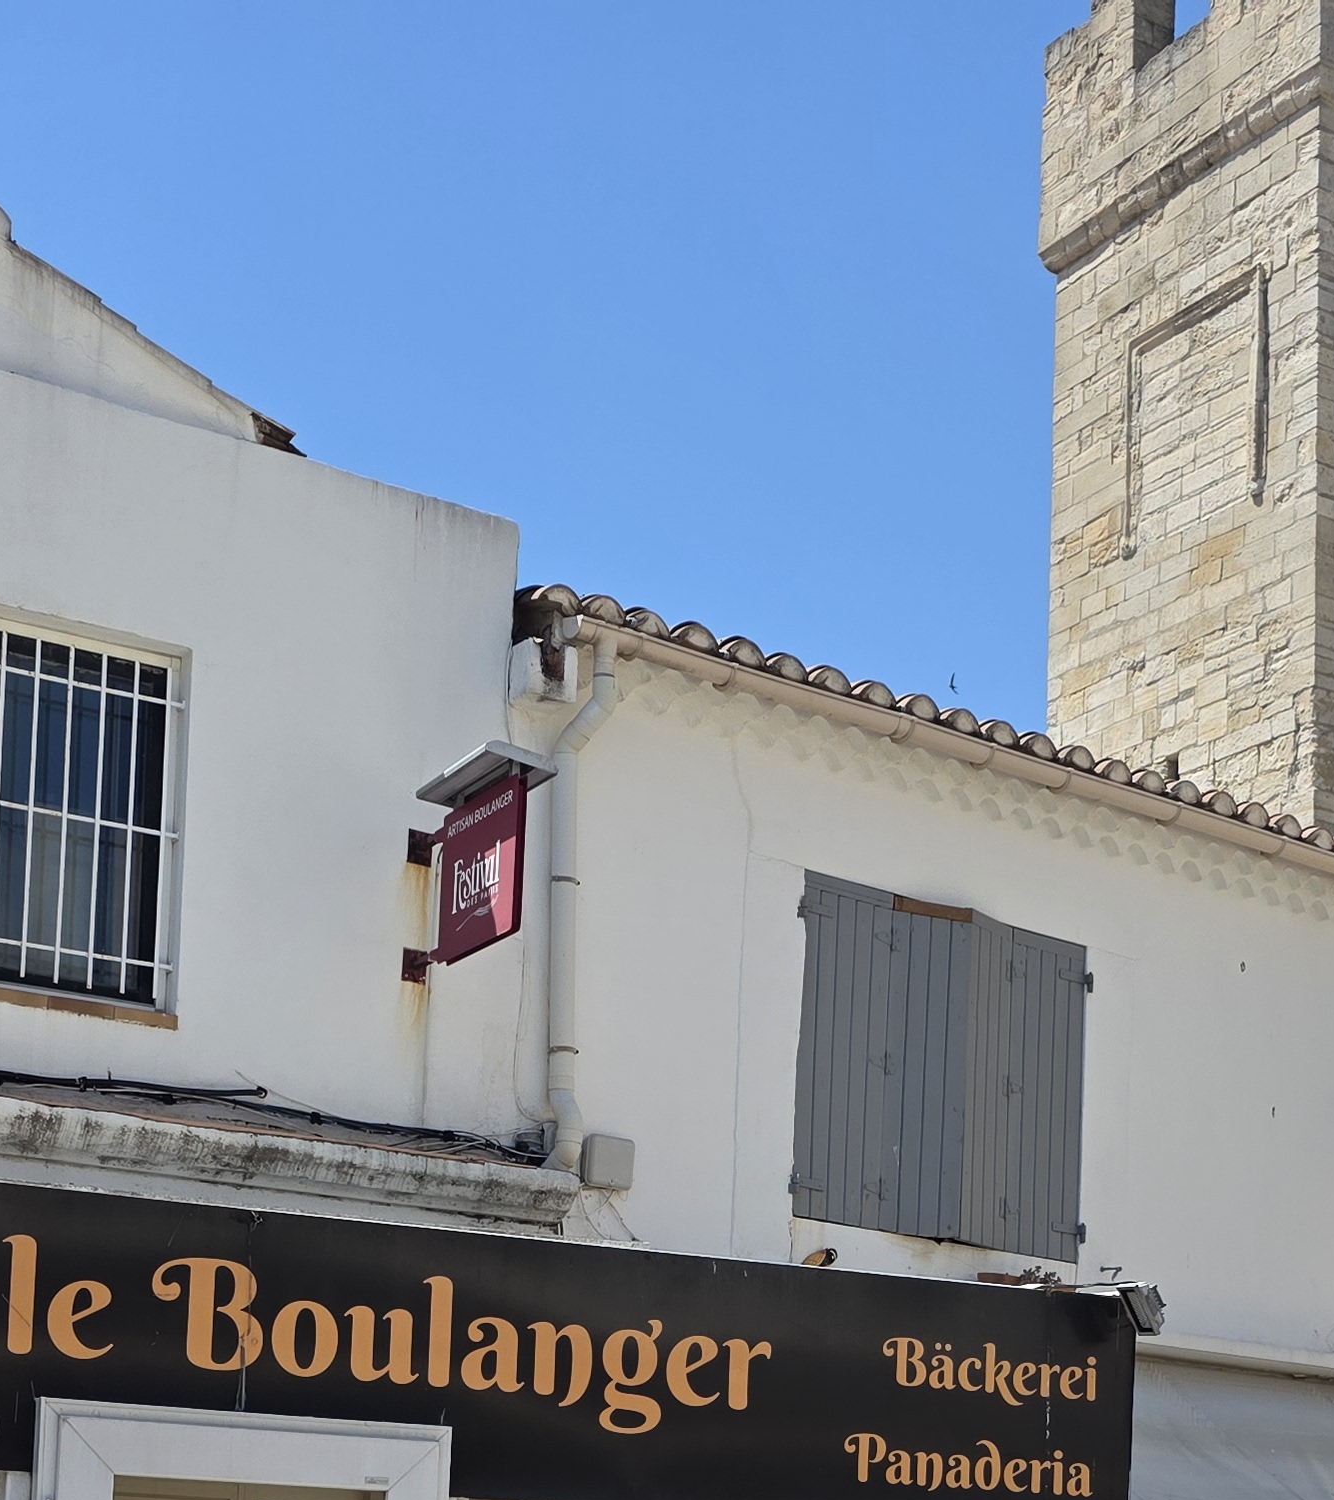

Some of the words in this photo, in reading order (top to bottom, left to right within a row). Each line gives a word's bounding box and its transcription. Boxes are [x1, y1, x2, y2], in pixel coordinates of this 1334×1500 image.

[448, 812, 474, 839] ARTISAN
[474, 789, 514, 823] BOULANGER
[451, 840, 501, 915] Festival
[2, 1234, 114, 1360] le
[151, 1257, 772, 1434] Boulanger
[882, 1337, 1097, 1406] Bäckerei
[843, 1432, 1094, 1498] Panaderia
